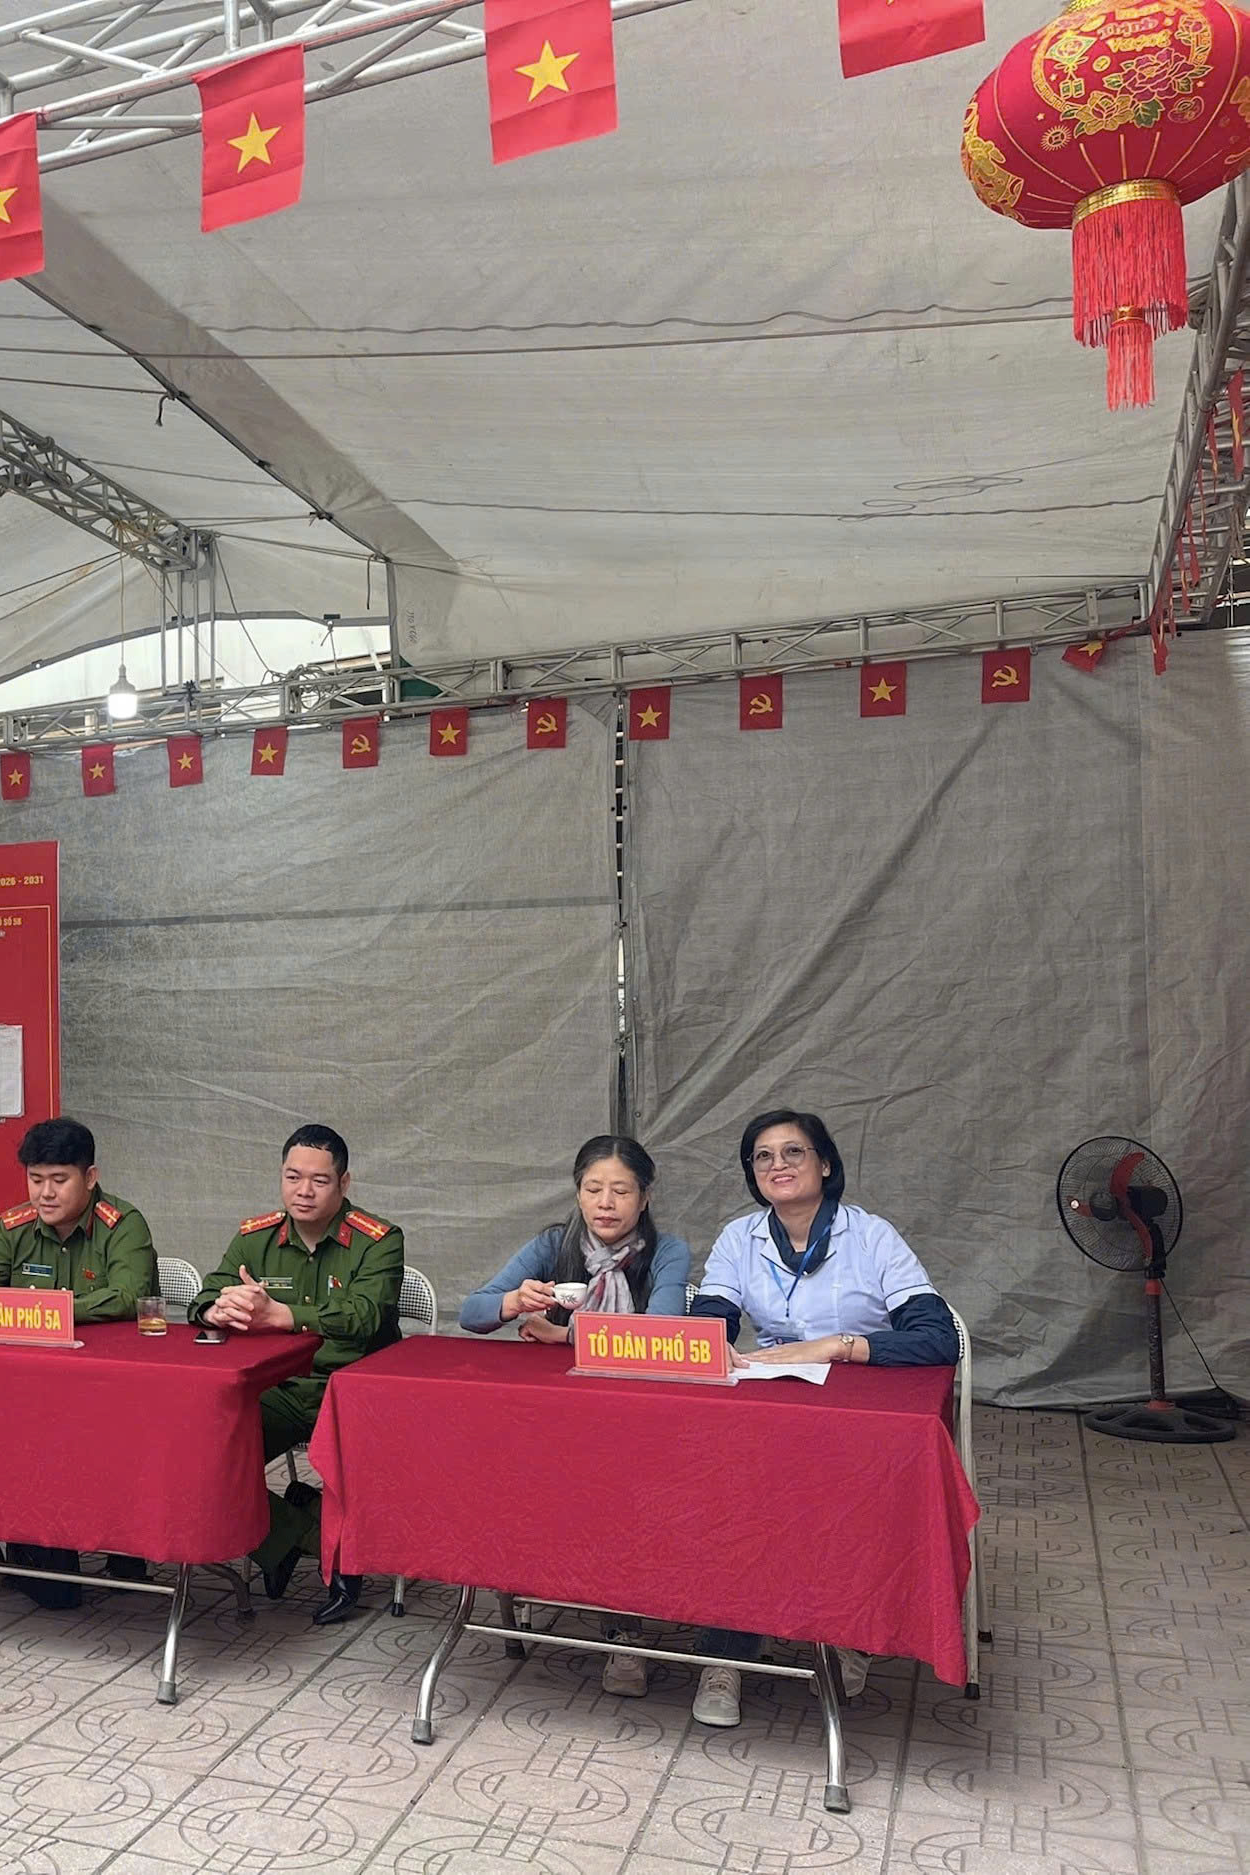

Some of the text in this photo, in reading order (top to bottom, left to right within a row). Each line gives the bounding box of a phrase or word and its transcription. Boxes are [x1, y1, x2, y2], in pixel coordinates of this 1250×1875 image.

[23, 875, 44, 885] 2031
[16, 1301, 42, 1329] PHỐ
[44, 1309, 62, 1330] 5A
[588, 1324, 712, 1364] TỔ DÂN PHỐ 5B
